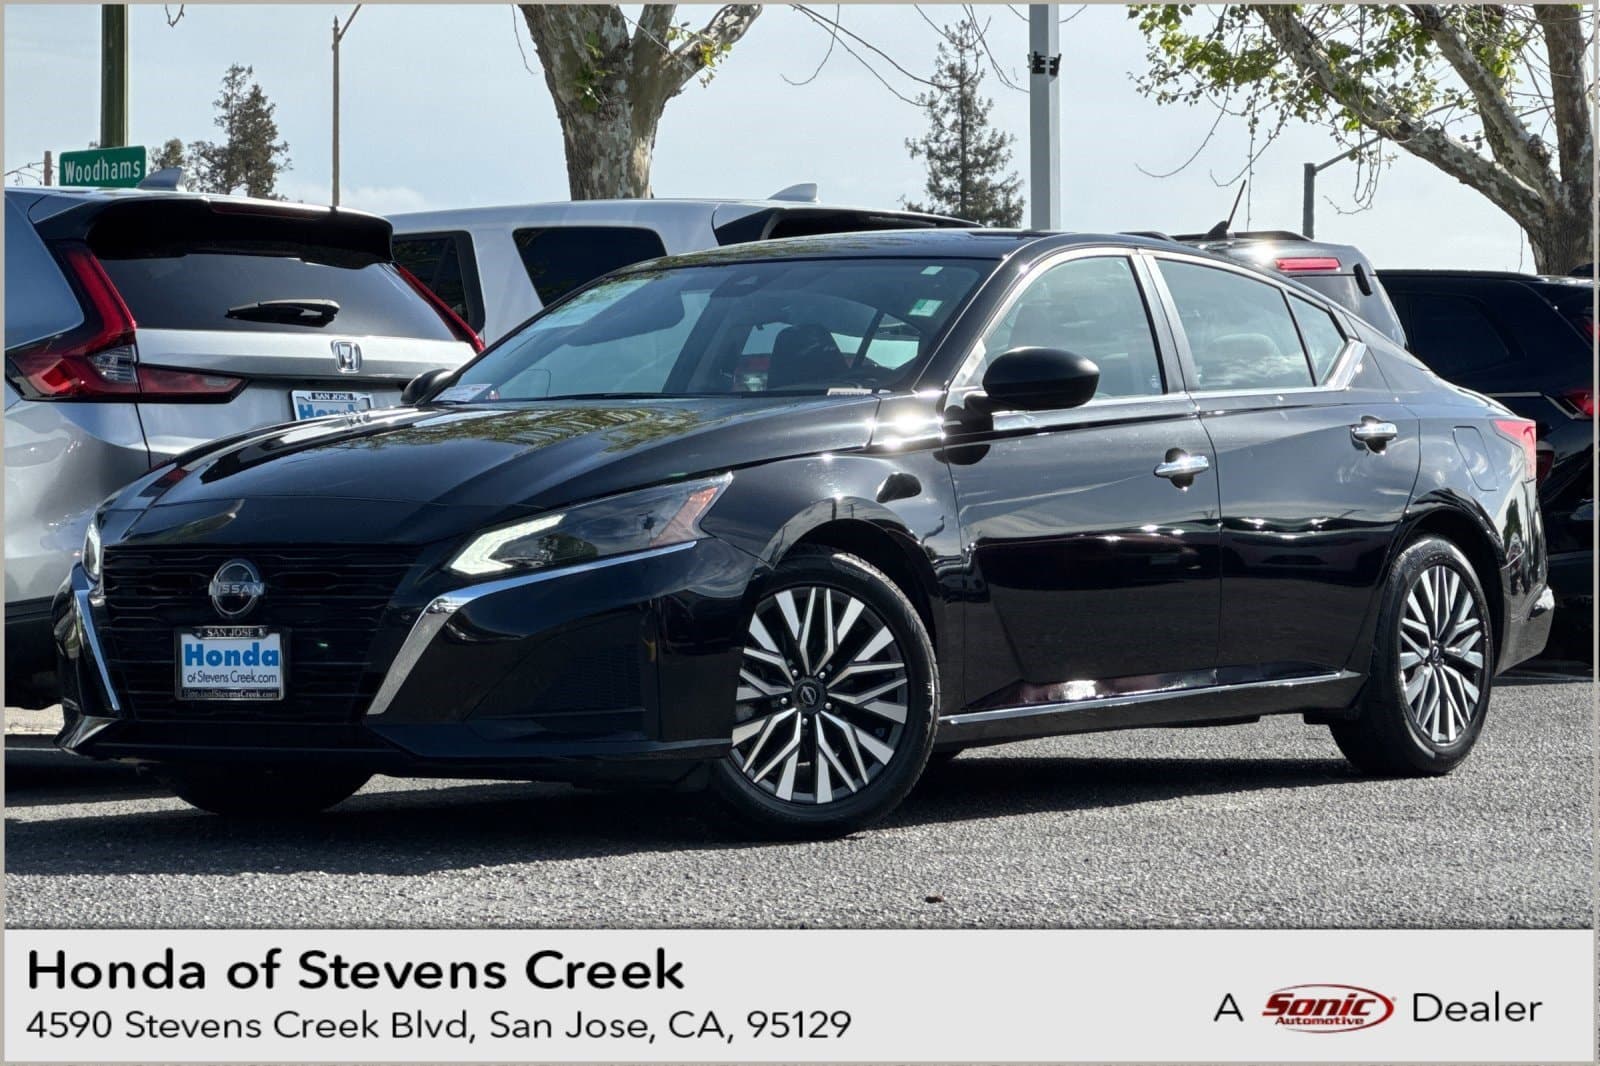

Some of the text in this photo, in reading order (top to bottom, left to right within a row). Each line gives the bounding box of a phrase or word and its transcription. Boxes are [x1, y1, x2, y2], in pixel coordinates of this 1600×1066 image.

[64, 157, 141, 184] Woodhams
[315, 392, 351, 400] SAN JOSE
[209, 584, 263, 594] NISSAN
[207, 628, 255, 638] SAN JOSE
[185, 642, 279, 667] Honda
[187, 671, 196, 683] of
